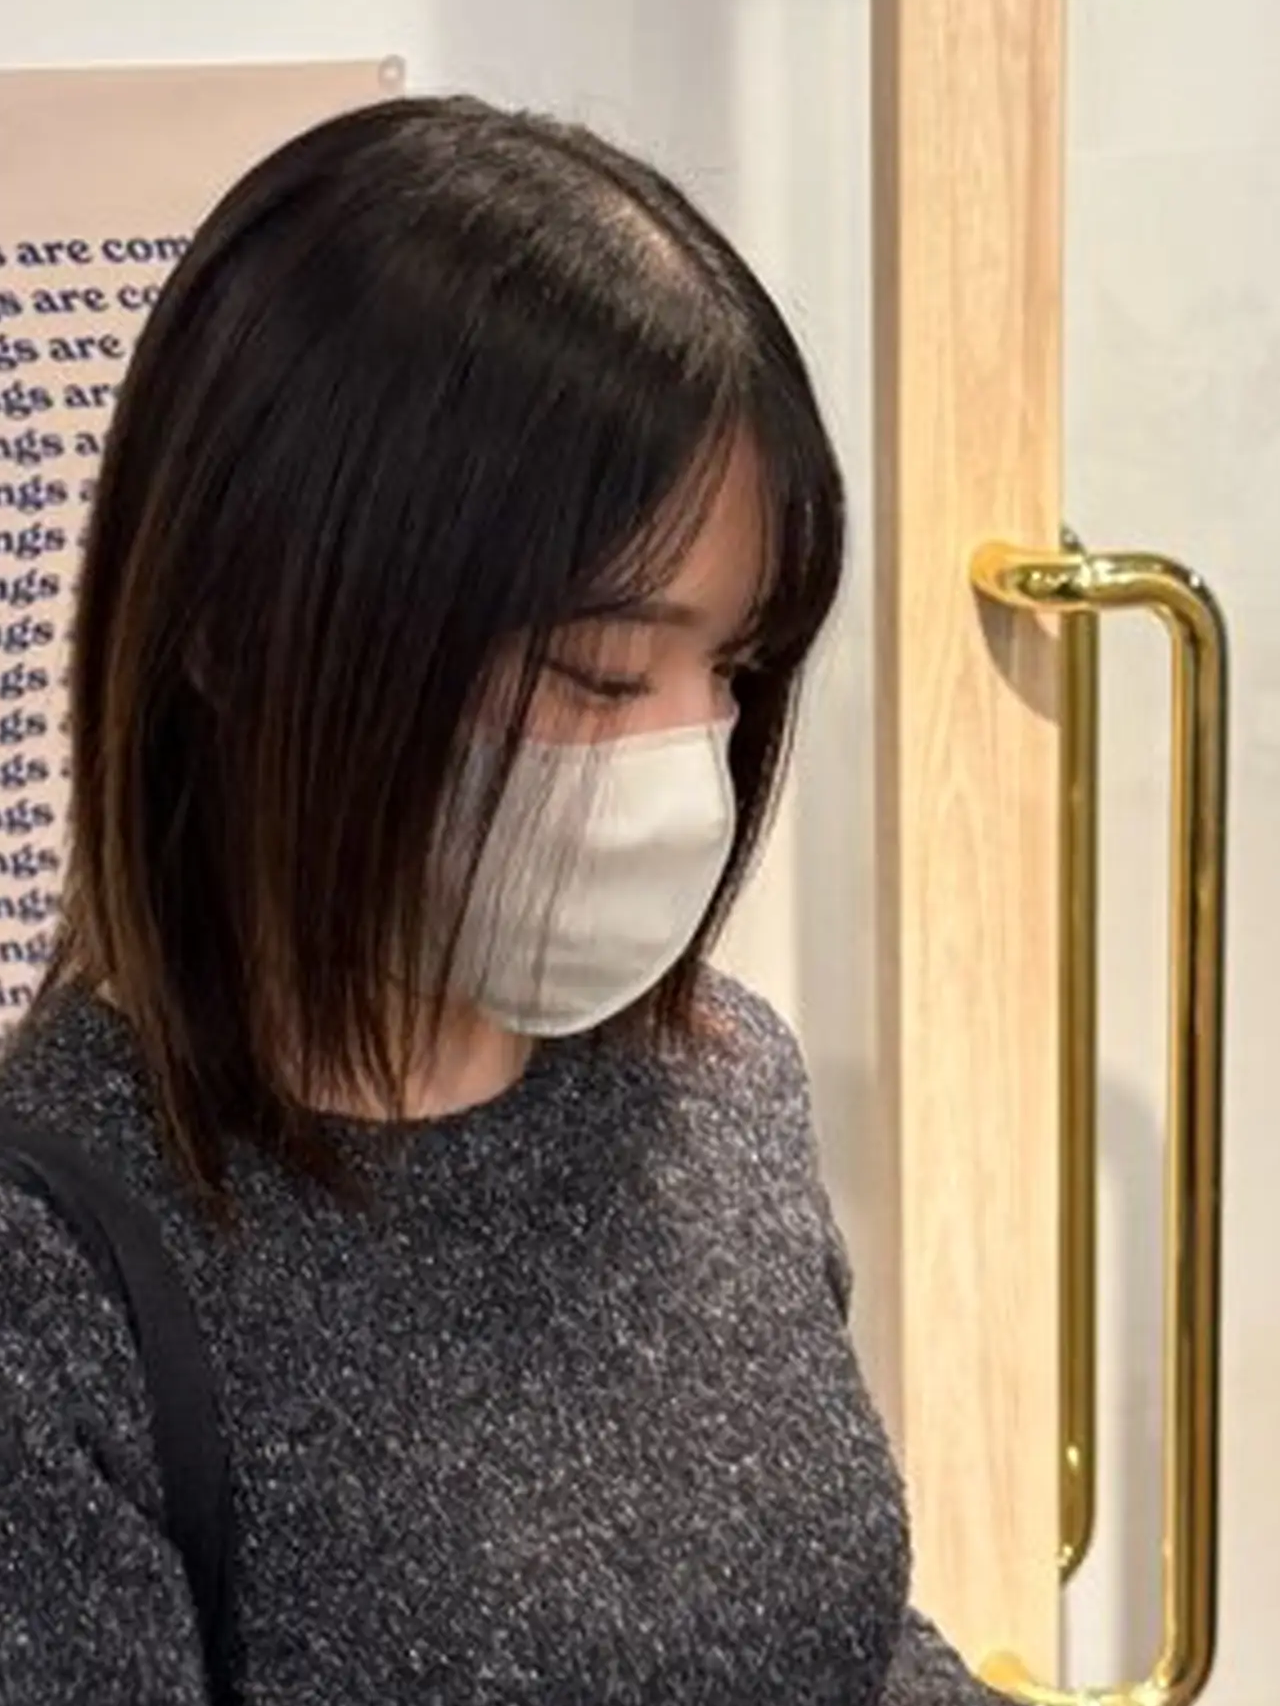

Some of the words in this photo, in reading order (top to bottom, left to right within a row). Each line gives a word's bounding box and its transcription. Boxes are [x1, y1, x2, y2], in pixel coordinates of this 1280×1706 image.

[16, 239, 92, 265] are
[33, 288, 108, 313] are
[49, 335, 123, 361] are
